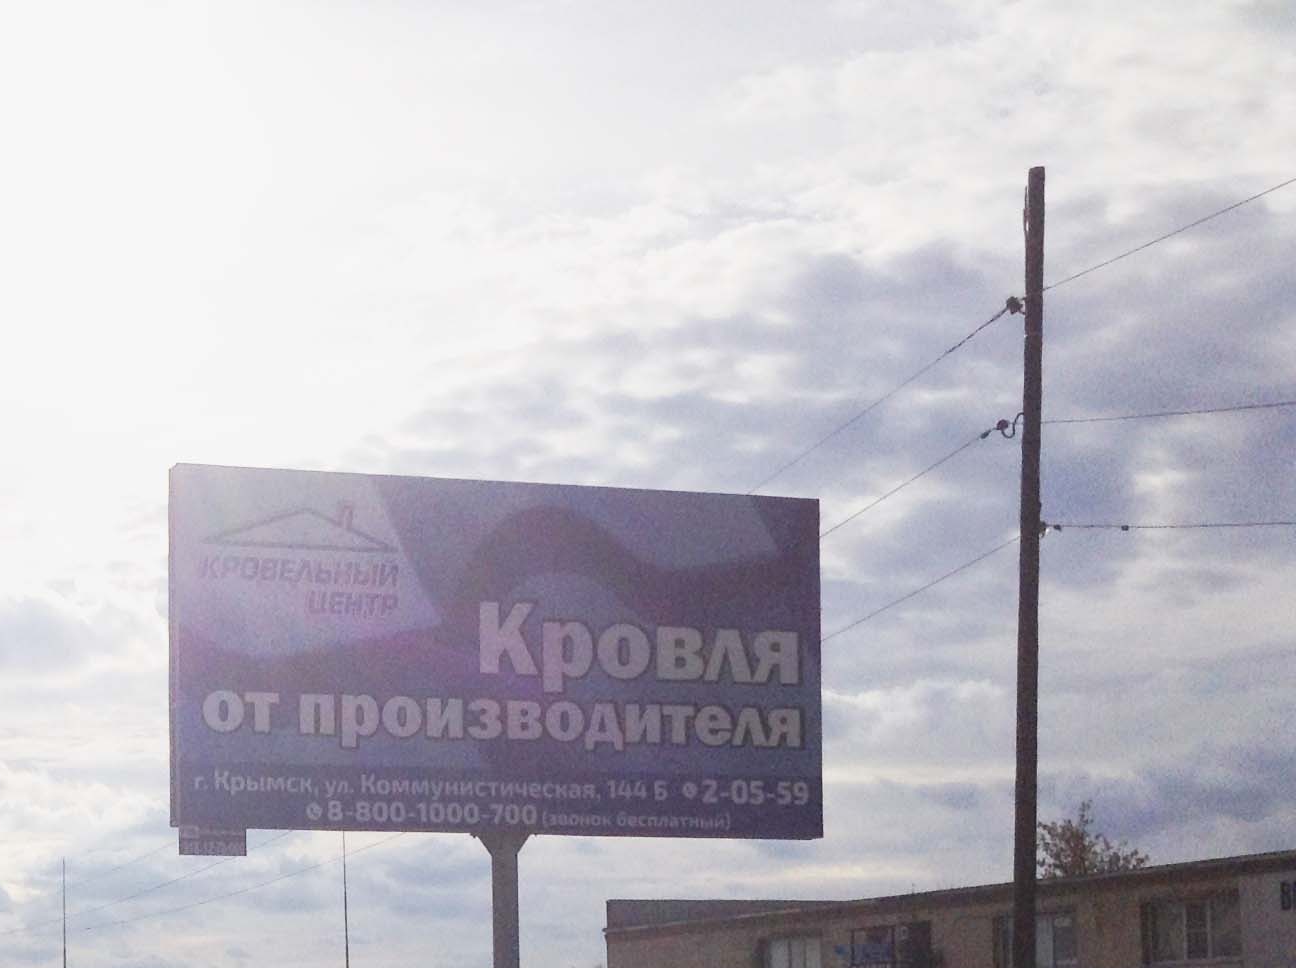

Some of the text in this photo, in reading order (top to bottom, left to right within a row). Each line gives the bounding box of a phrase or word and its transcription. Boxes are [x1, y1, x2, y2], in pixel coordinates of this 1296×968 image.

[199, 555, 400, 588] КРОВЕЛЬНЫЙ
[306, 589, 399, 617] ЦЕНТР
[478, 601, 799, 692] Кровля
[204, 690, 801, 751] от производителя
[194, 777, 209, 791] г.
[214, 770, 321, 797] Крымск,
[361, 773, 601, 803] Коммунистическая,
[607, 782, 648, 800] 144
[701, 779, 809, 805] 2-05-59
[328, 802, 732, 831] 8-800-1000-700 (звонок бесплатный)
